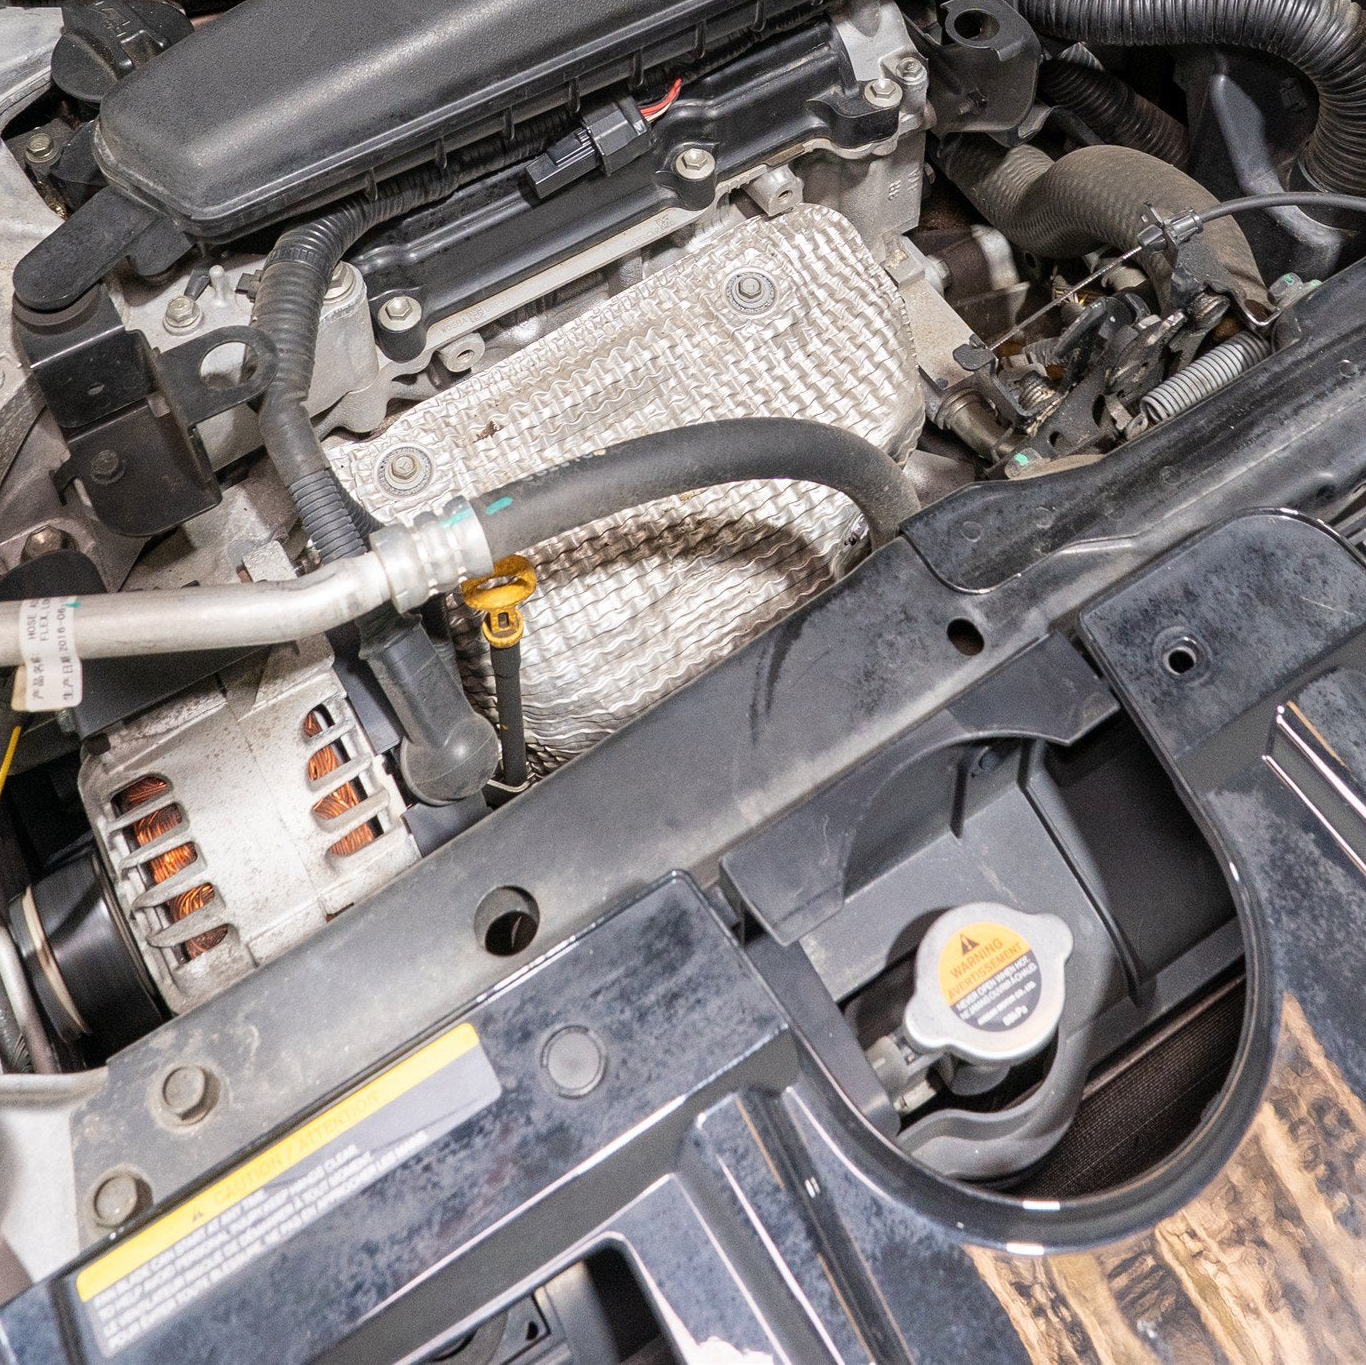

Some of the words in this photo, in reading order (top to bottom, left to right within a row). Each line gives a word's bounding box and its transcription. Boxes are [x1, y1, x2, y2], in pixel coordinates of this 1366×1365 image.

[948, 943, 1023, 998] AVERTISSEMENT
[950, 938, 1003, 978] WARNING
[212, 1152, 284, 1206] CAUTION
[295, 1088, 381, 1151] ATTENTION
